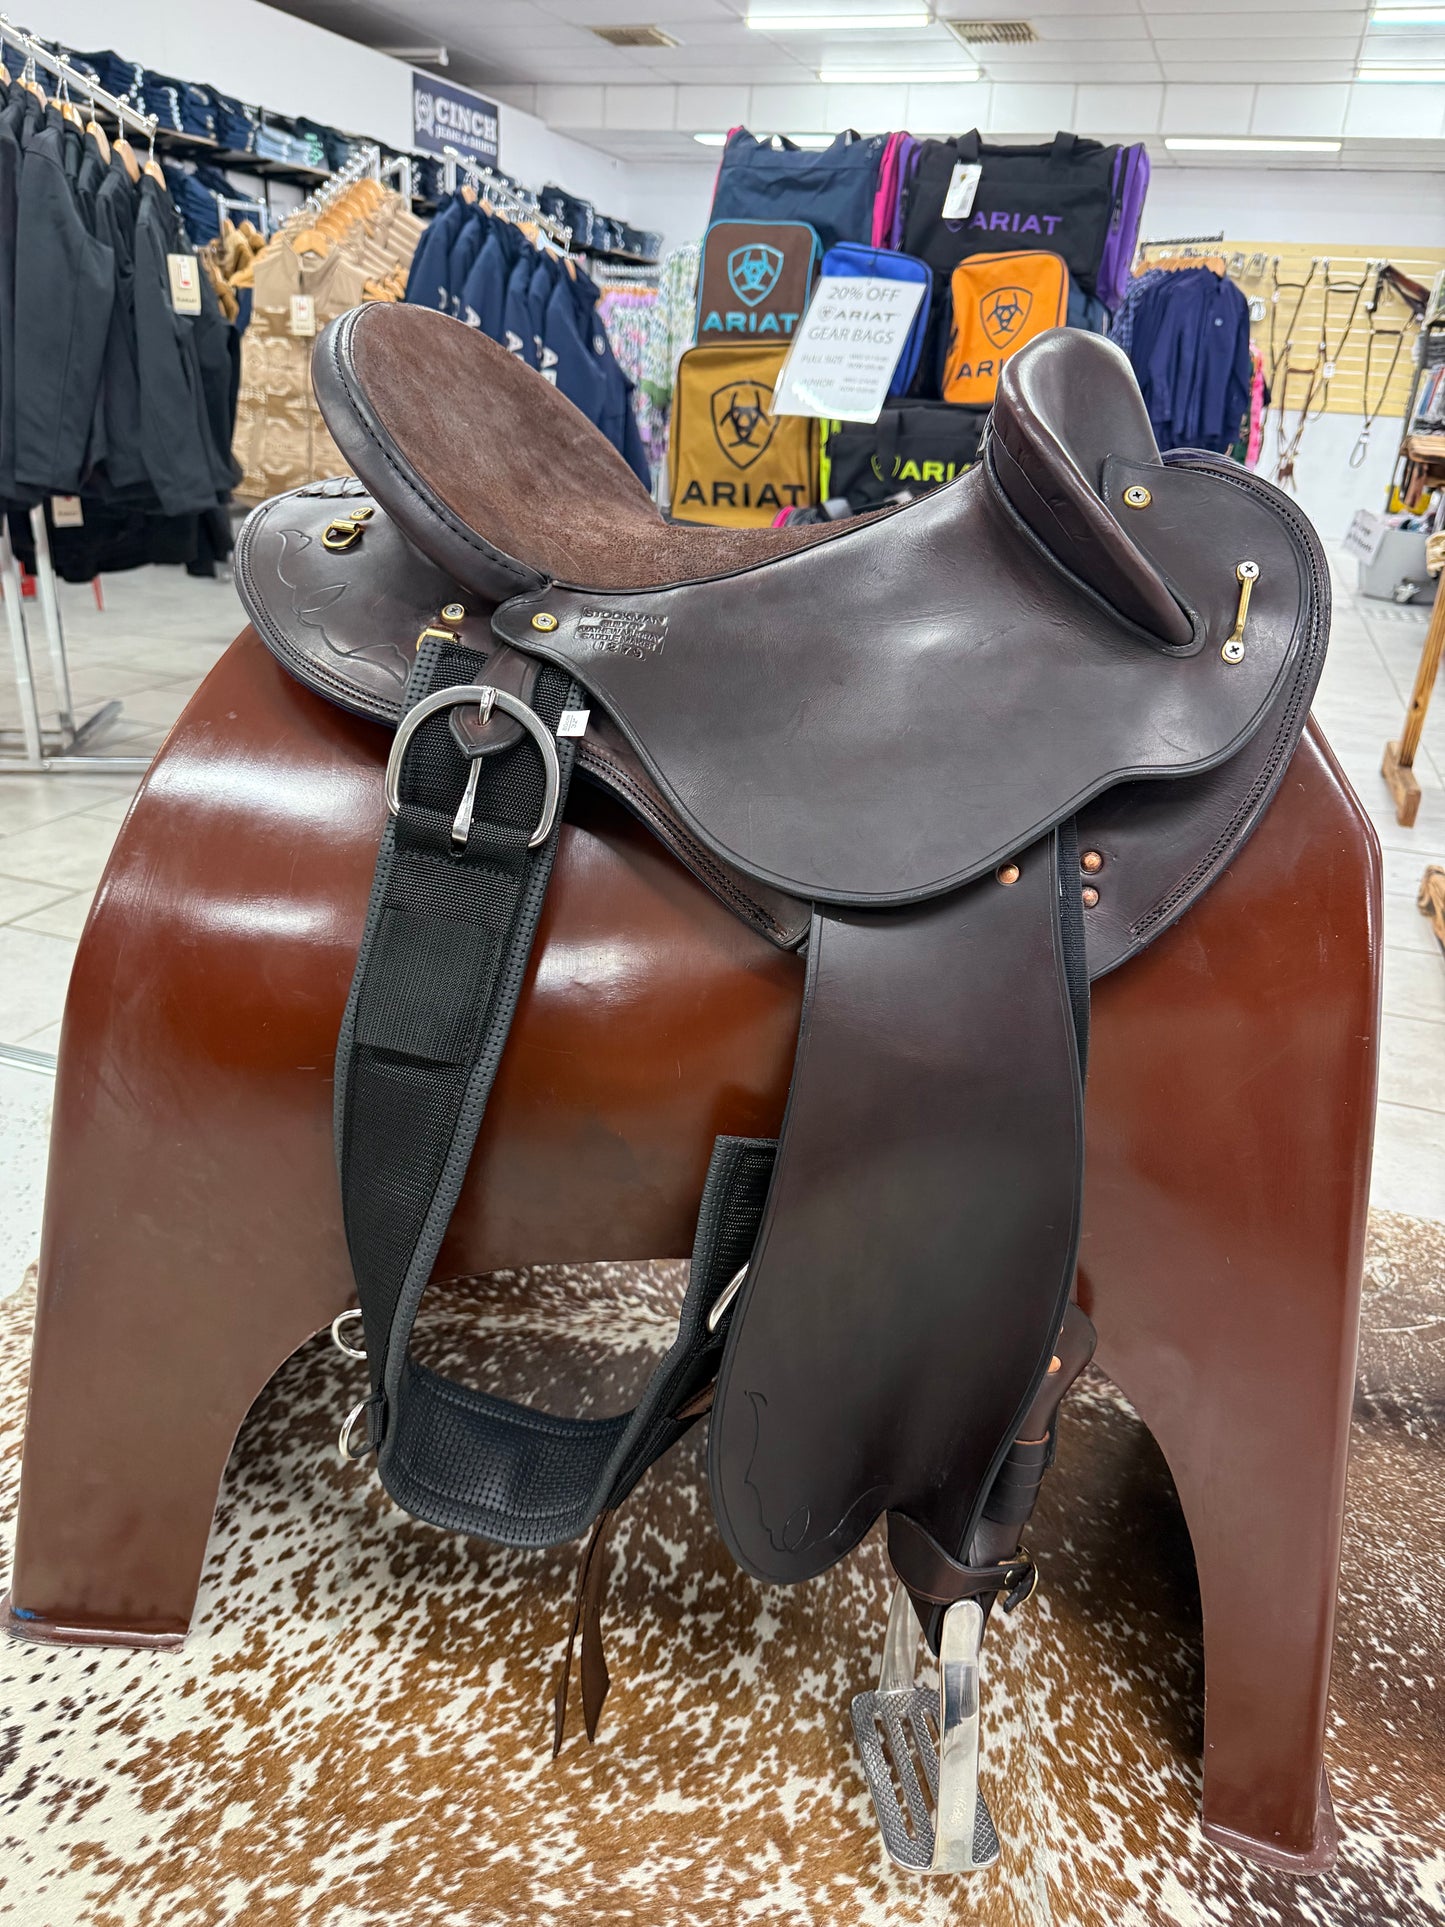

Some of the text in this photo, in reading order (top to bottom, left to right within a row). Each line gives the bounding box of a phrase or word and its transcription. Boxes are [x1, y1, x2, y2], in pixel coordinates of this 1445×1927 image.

[435, 96, 497, 143] CINCH
[968, 211, 1063, 235] ARIAT
[827, 286, 902, 301] 20% OFF
[703, 311, 799, 334] ARIAT
[835, 310, 897, 323] ARIAT
[808, 326, 897, 345] GEAR BAGS
[956, 358, 1004, 380] ARI
[899, 460, 972, 482] ARI
[681, 480, 805, 508] ARIAT
[583, 607, 669, 626] STOCKMAN
